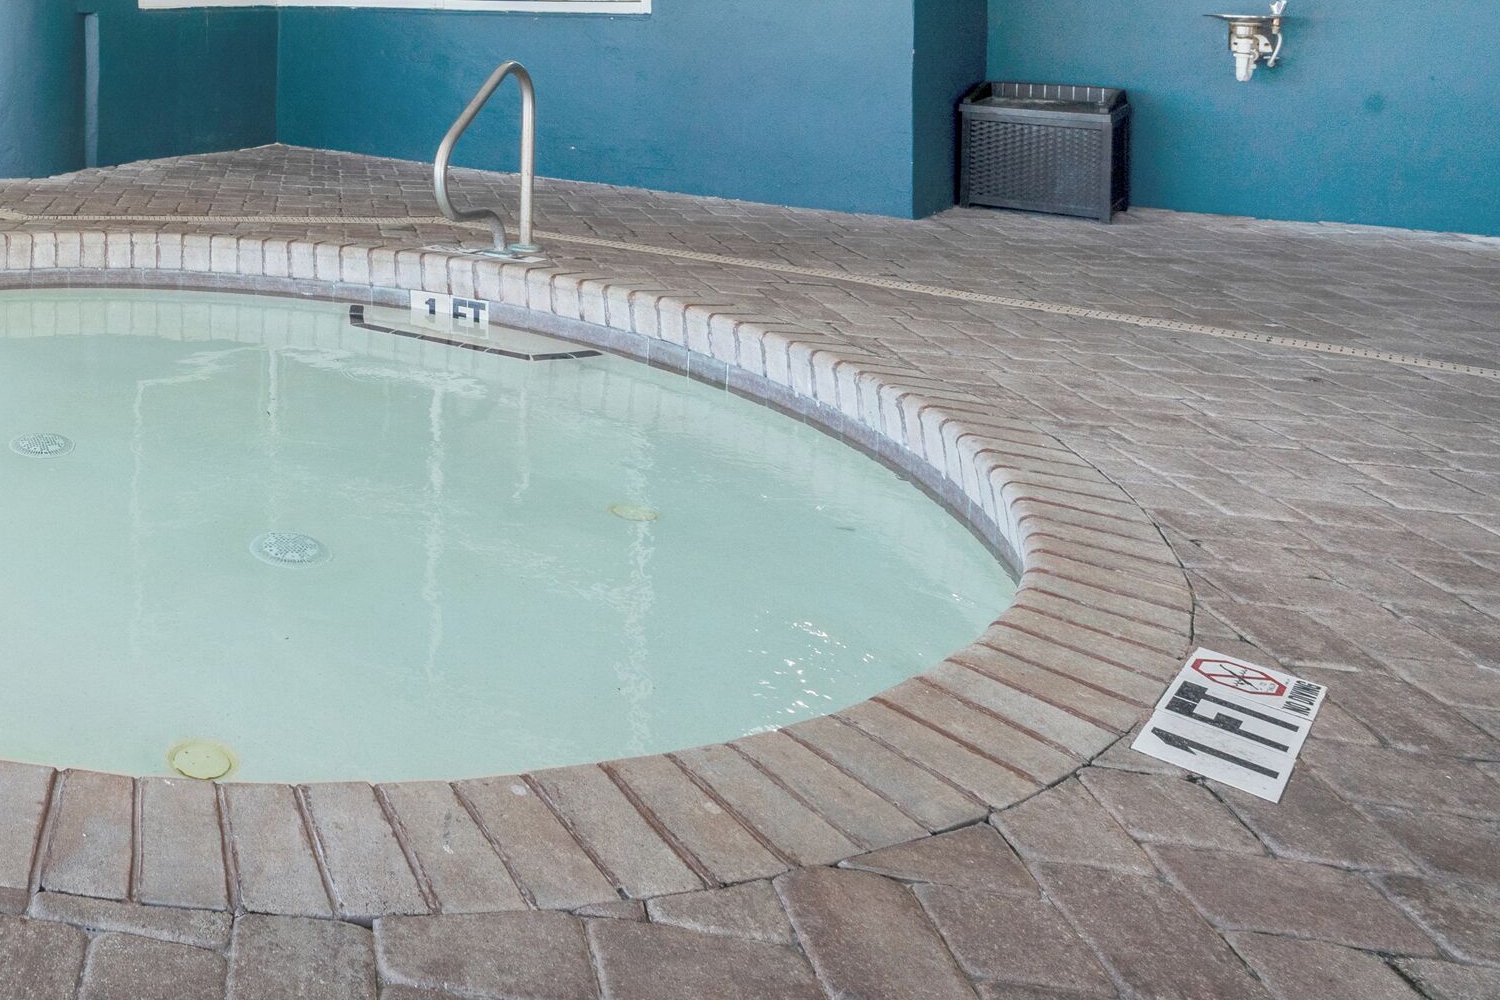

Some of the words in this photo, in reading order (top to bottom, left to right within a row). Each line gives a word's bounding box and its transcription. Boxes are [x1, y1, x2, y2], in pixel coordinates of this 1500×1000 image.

[425, 297, 436, 315] 1
[453, 298, 486, 323] FT
[1287, 680, 1322, 706] DIVING
[1165, 680, 1300, 753] FT
[1282, 700, 1311, 717] NO
[1151, 726, 1280, 779] 1
